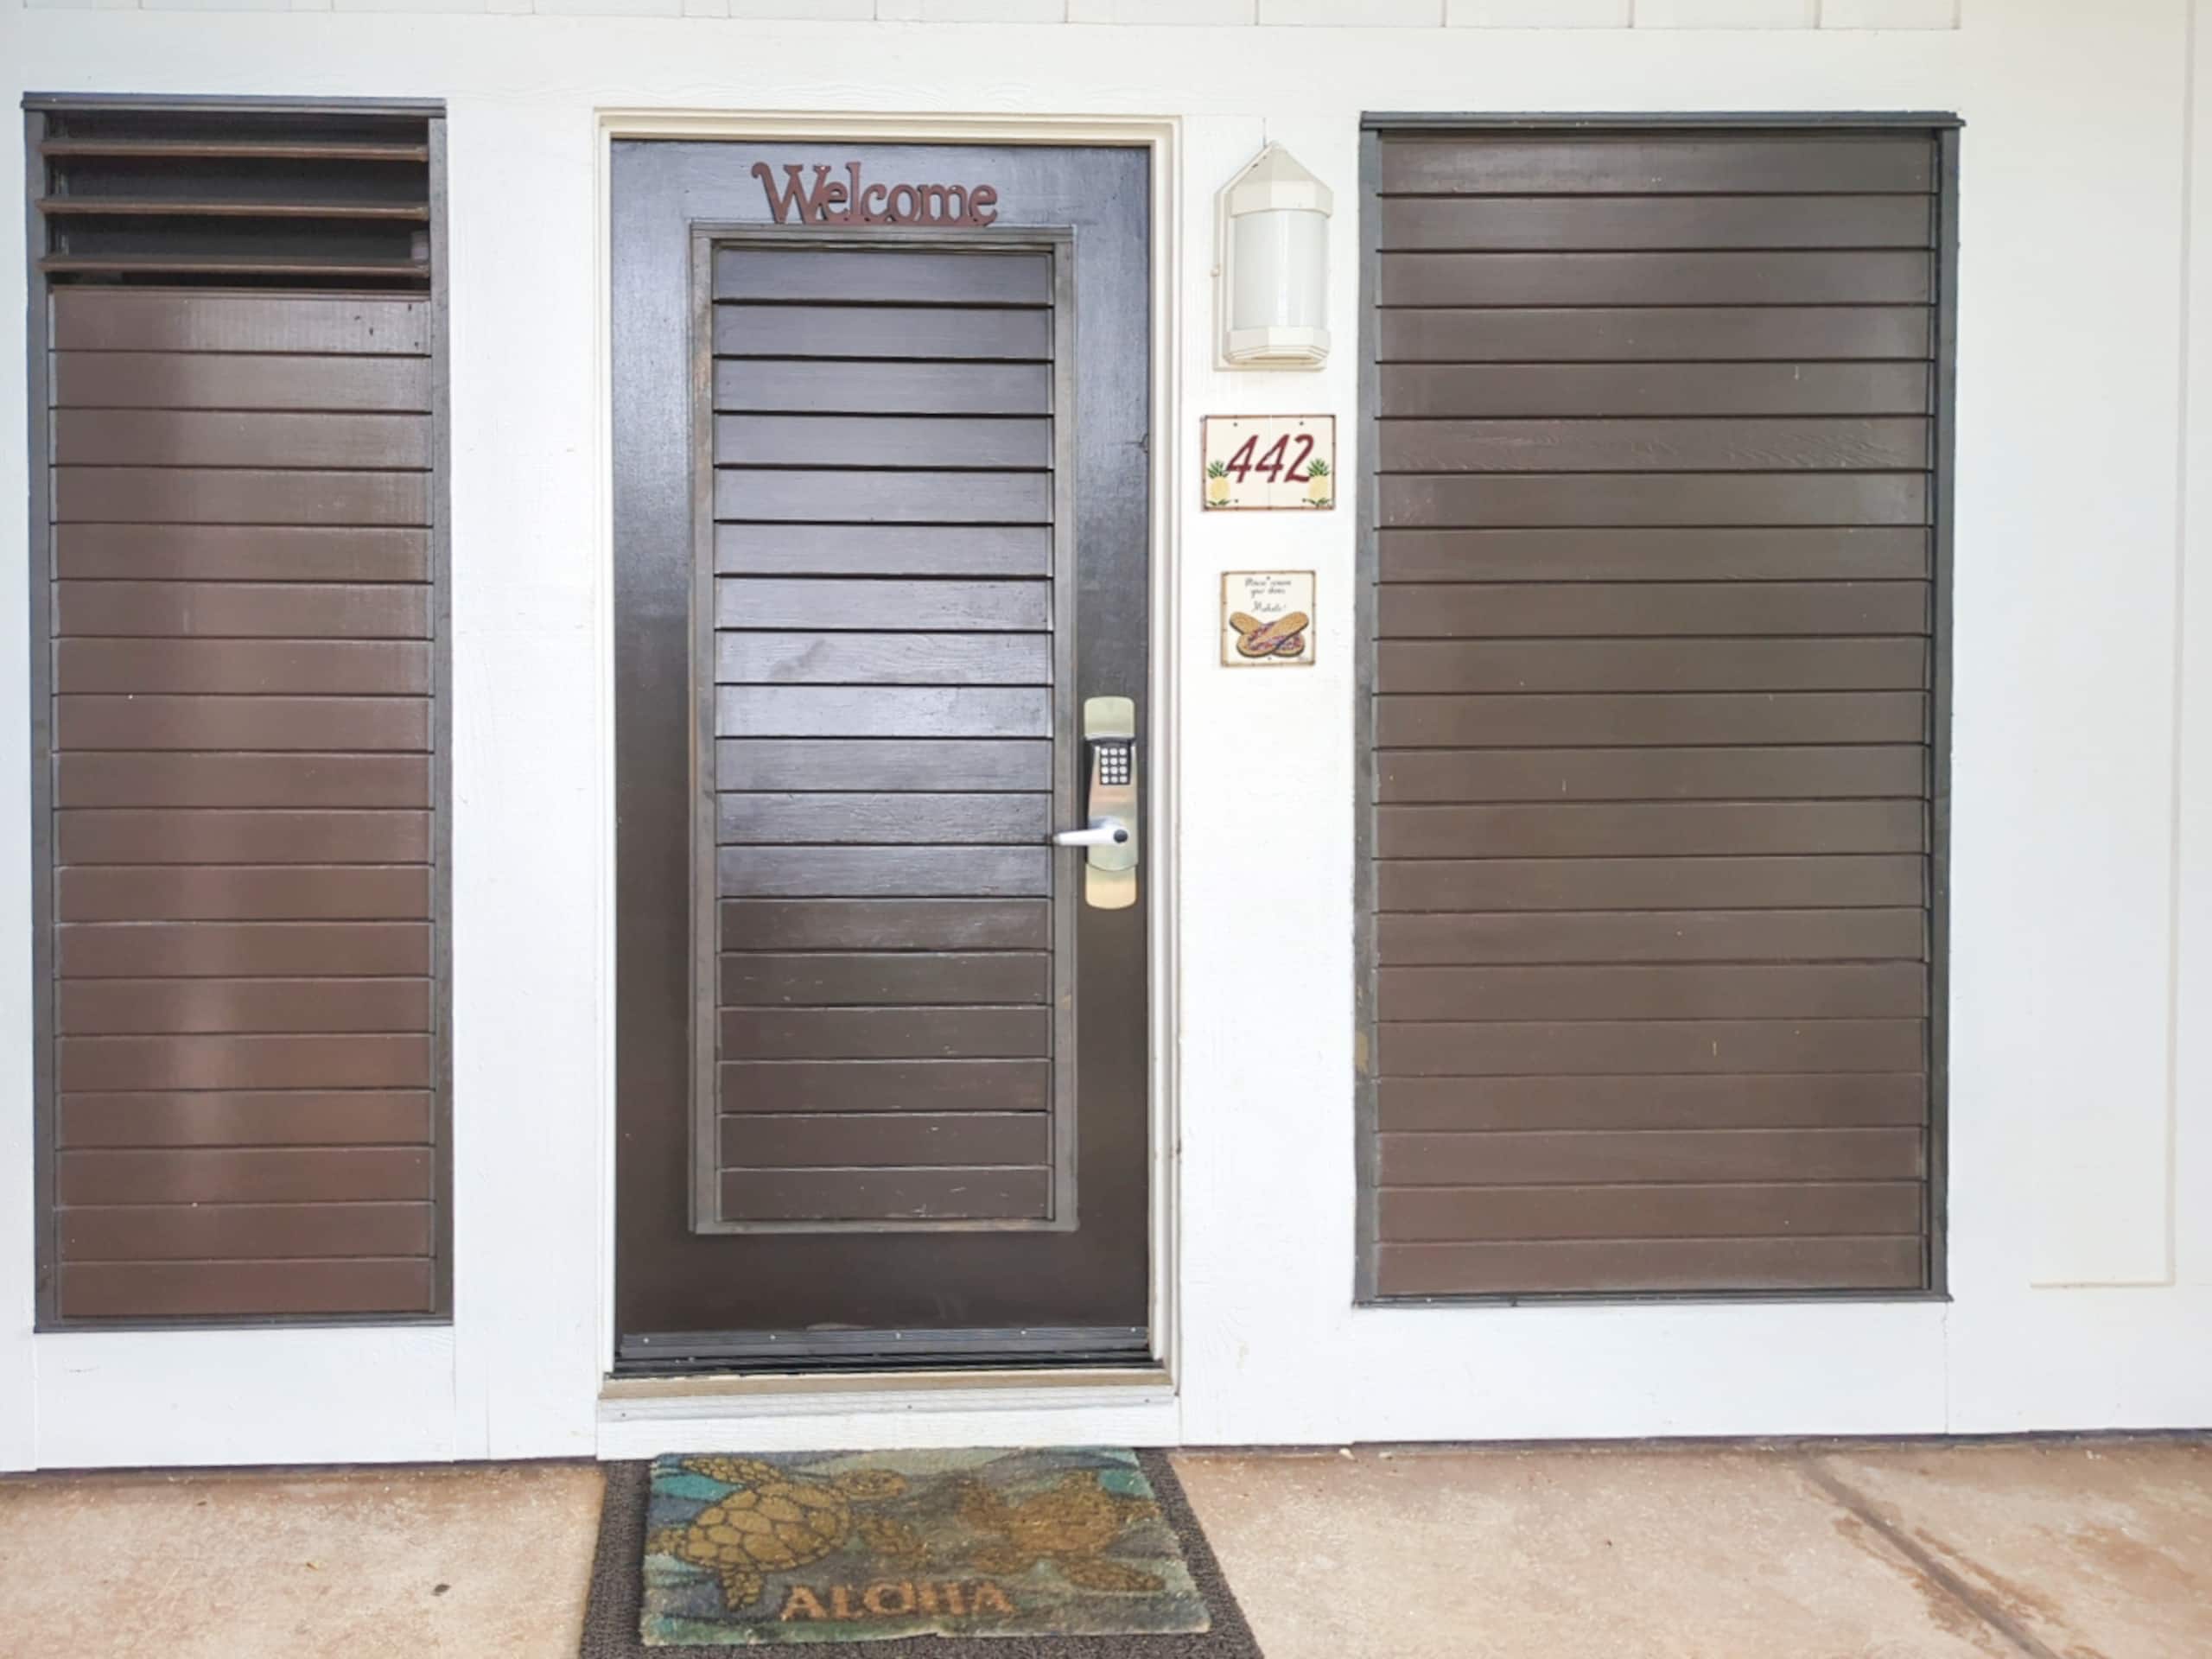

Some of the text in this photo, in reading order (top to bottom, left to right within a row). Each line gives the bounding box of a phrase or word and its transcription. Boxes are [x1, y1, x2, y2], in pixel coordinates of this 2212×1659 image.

[751, 162, 998, 226] Welcome
[1225, 433, 1314, 484] 442
[781, 1581, 1015, 1622] ALOHA
